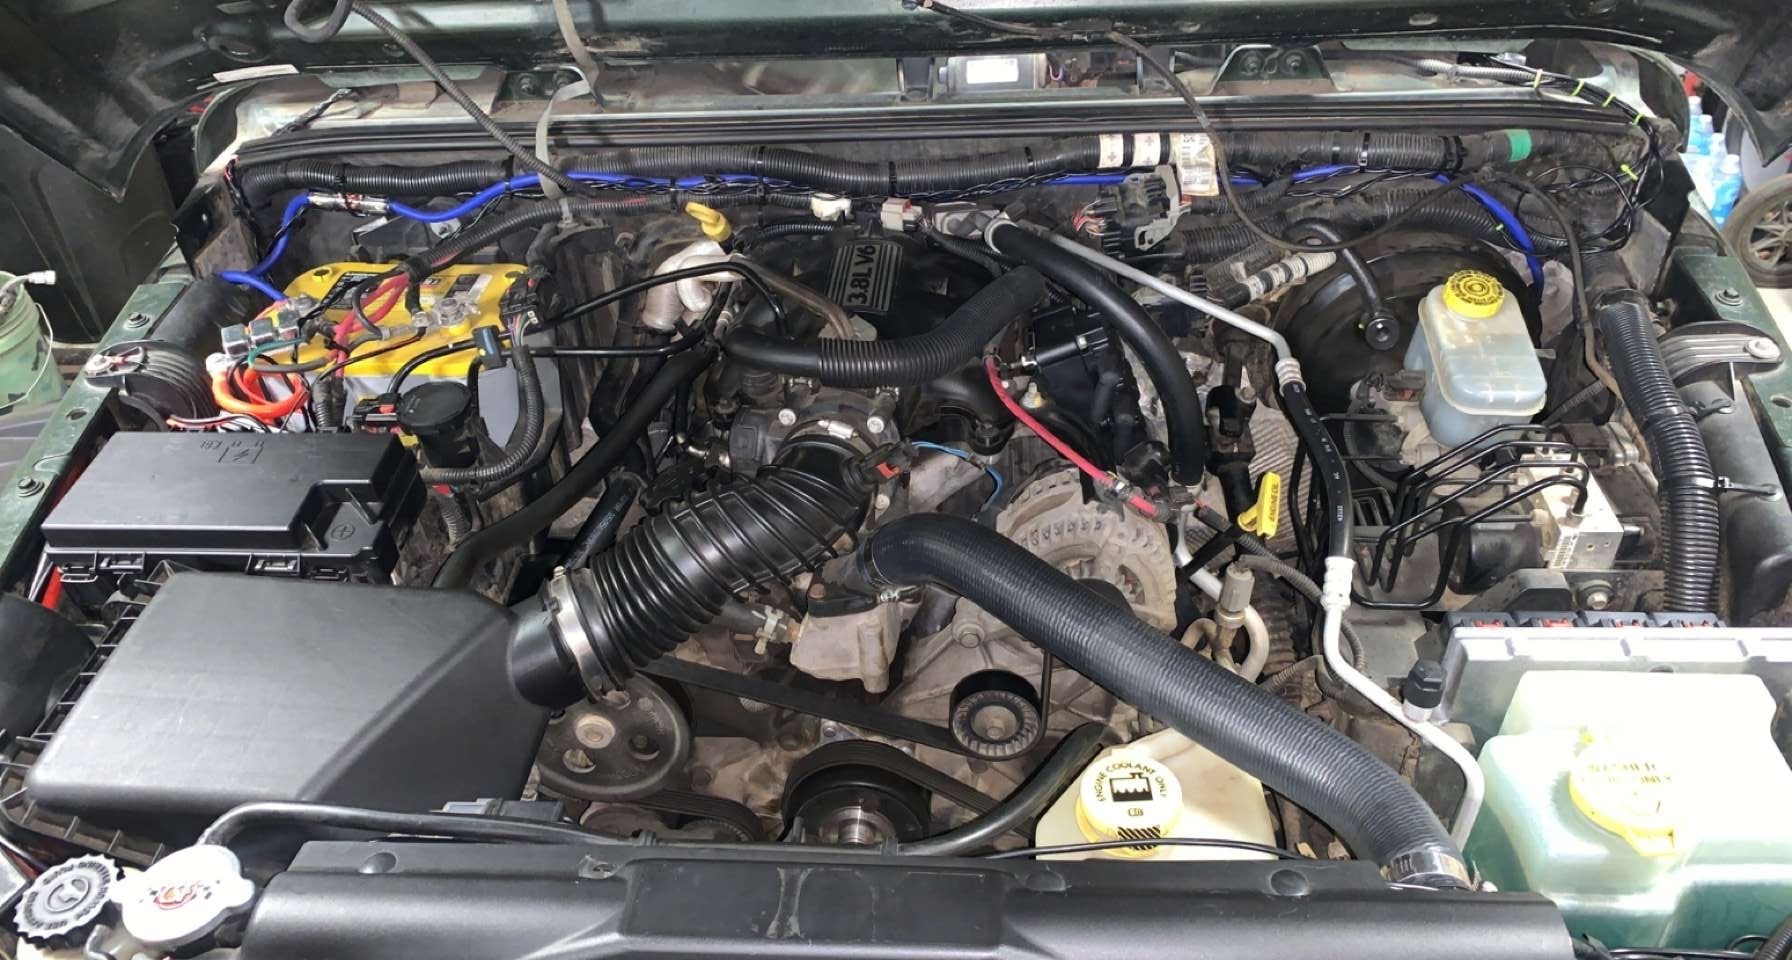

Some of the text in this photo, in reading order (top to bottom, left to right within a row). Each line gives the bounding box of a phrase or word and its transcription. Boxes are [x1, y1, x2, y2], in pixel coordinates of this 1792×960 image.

[1094, 761, 1167, 802] ENGINE COOLANT ONLY
